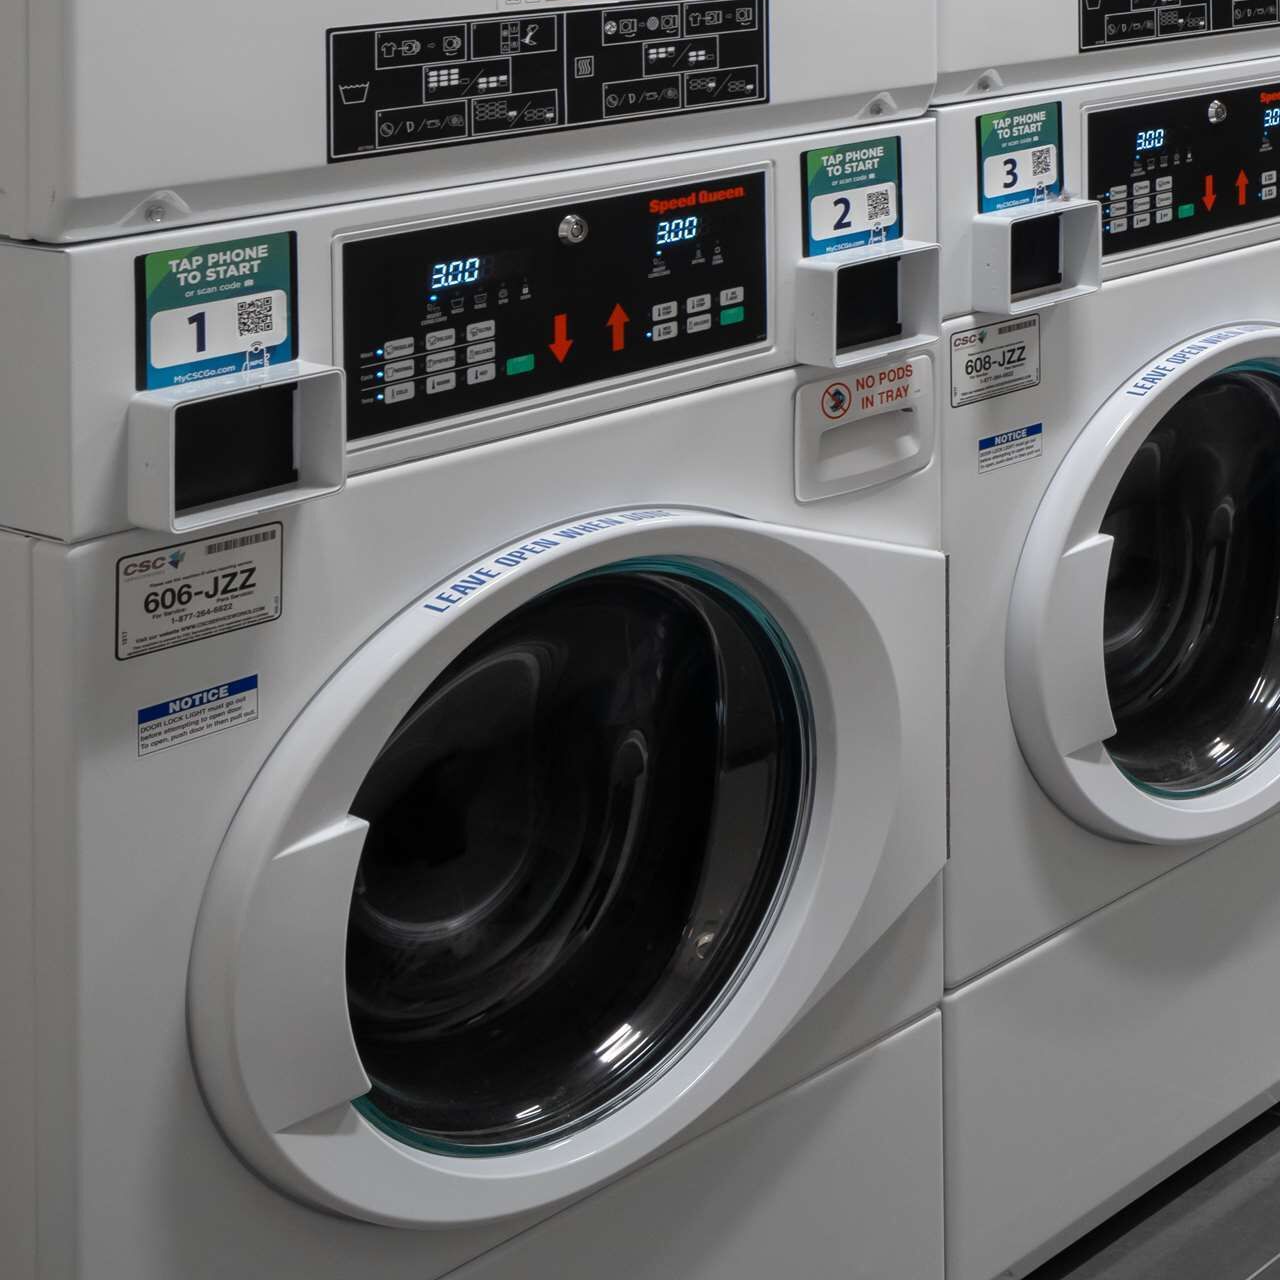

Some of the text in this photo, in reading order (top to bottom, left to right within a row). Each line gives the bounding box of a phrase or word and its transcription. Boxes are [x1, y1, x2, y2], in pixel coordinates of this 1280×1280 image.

[992, 111, 1047, 130] TAP PHONE
[997, 123, 1042, 139] TO START
[1136, 129, 1164, 150] 3.00
[822, 146, 884, 167] TAP PHONE
[826, 158, 880, 177] TO START
[1003, 158, 1018, 189] 3
[650, 186, 744, 214] Speed Queen
[833, 197, 852, 231] 2
[656, 216, 697, 245] 3.00
[168, 244, 269, 273] TAP PHONE
[177, 260, 261, 286] TO START
[432, 257, 480, 289] 3.00
[185, 281, 241, 298] or scan code
[187, 311, 206, 353] 1
[953, 334, 977, 348] CSC
[174, 364, 236, 384] MyCSCGo.com
[965, 345, 1026, 376] 608-JZZ
[1127, 365, 1175, 396] LEAVE
[1172, 344, 1207, 366] OPEN
[856, 364, 913, 392] NO PODS
[861, 384, 910, 410] IN TRAY
[994, 429, 1028, 445] NOTICE
[123, 556, 166, 576] CSC
[424, 568, 502, 613] LEAVE
[503, 538, 560, 567] OPEN
[556, 517, 624, 540] WHEN
[144, 567, 256, 614] 606-JZZ
[169, 685, 229, 713] NOTICE
[141, 696, 246, 734] DOOR LOCK LIGHT must go out
[141, 731, 162, 741] before
[164, 721, 200, 735] attempting
[209, 711, 225, 721] open
[227, 706, 242, 714] door
[141, 742, 149, 750] To
[171, 731, 188, 742] push
[189, 725, 204, 735] door
[206, 721, 213, 729] in
[214, 717, 229, 726] then
[230, 712, 242, 723] pull
